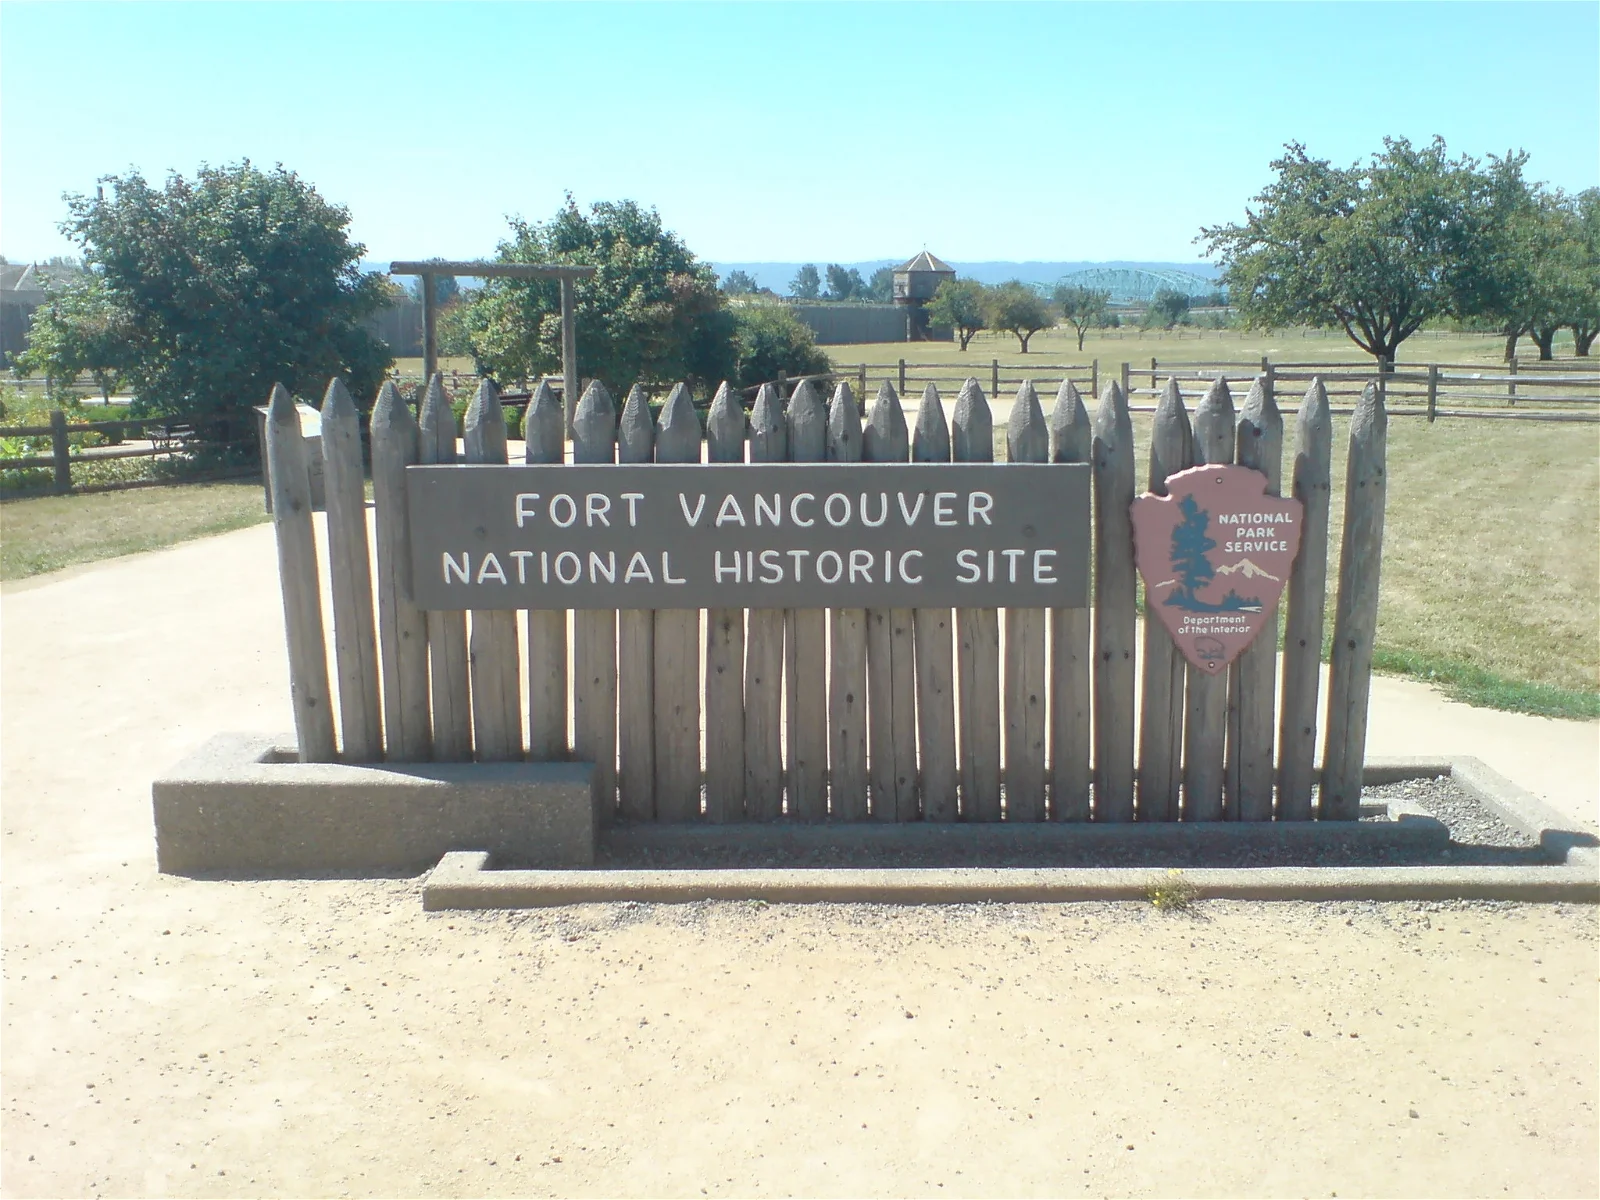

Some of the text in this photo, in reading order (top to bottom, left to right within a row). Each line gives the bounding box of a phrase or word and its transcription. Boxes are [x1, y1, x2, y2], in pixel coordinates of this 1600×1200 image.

[516, 491, 994, 528] FORT VANCOUVER
[1218, 512, 1293, 524] NATIONAL
[1236, 527, 1275, 538] PARK
[1224, 540, 1288, 553] SERVICE
[442, 549, 1058, 585] NATIONAL HISTORIC SITE
[1183, 615, 1246, 626] Department
[1178, 625, 1251, 634] of the Interior
